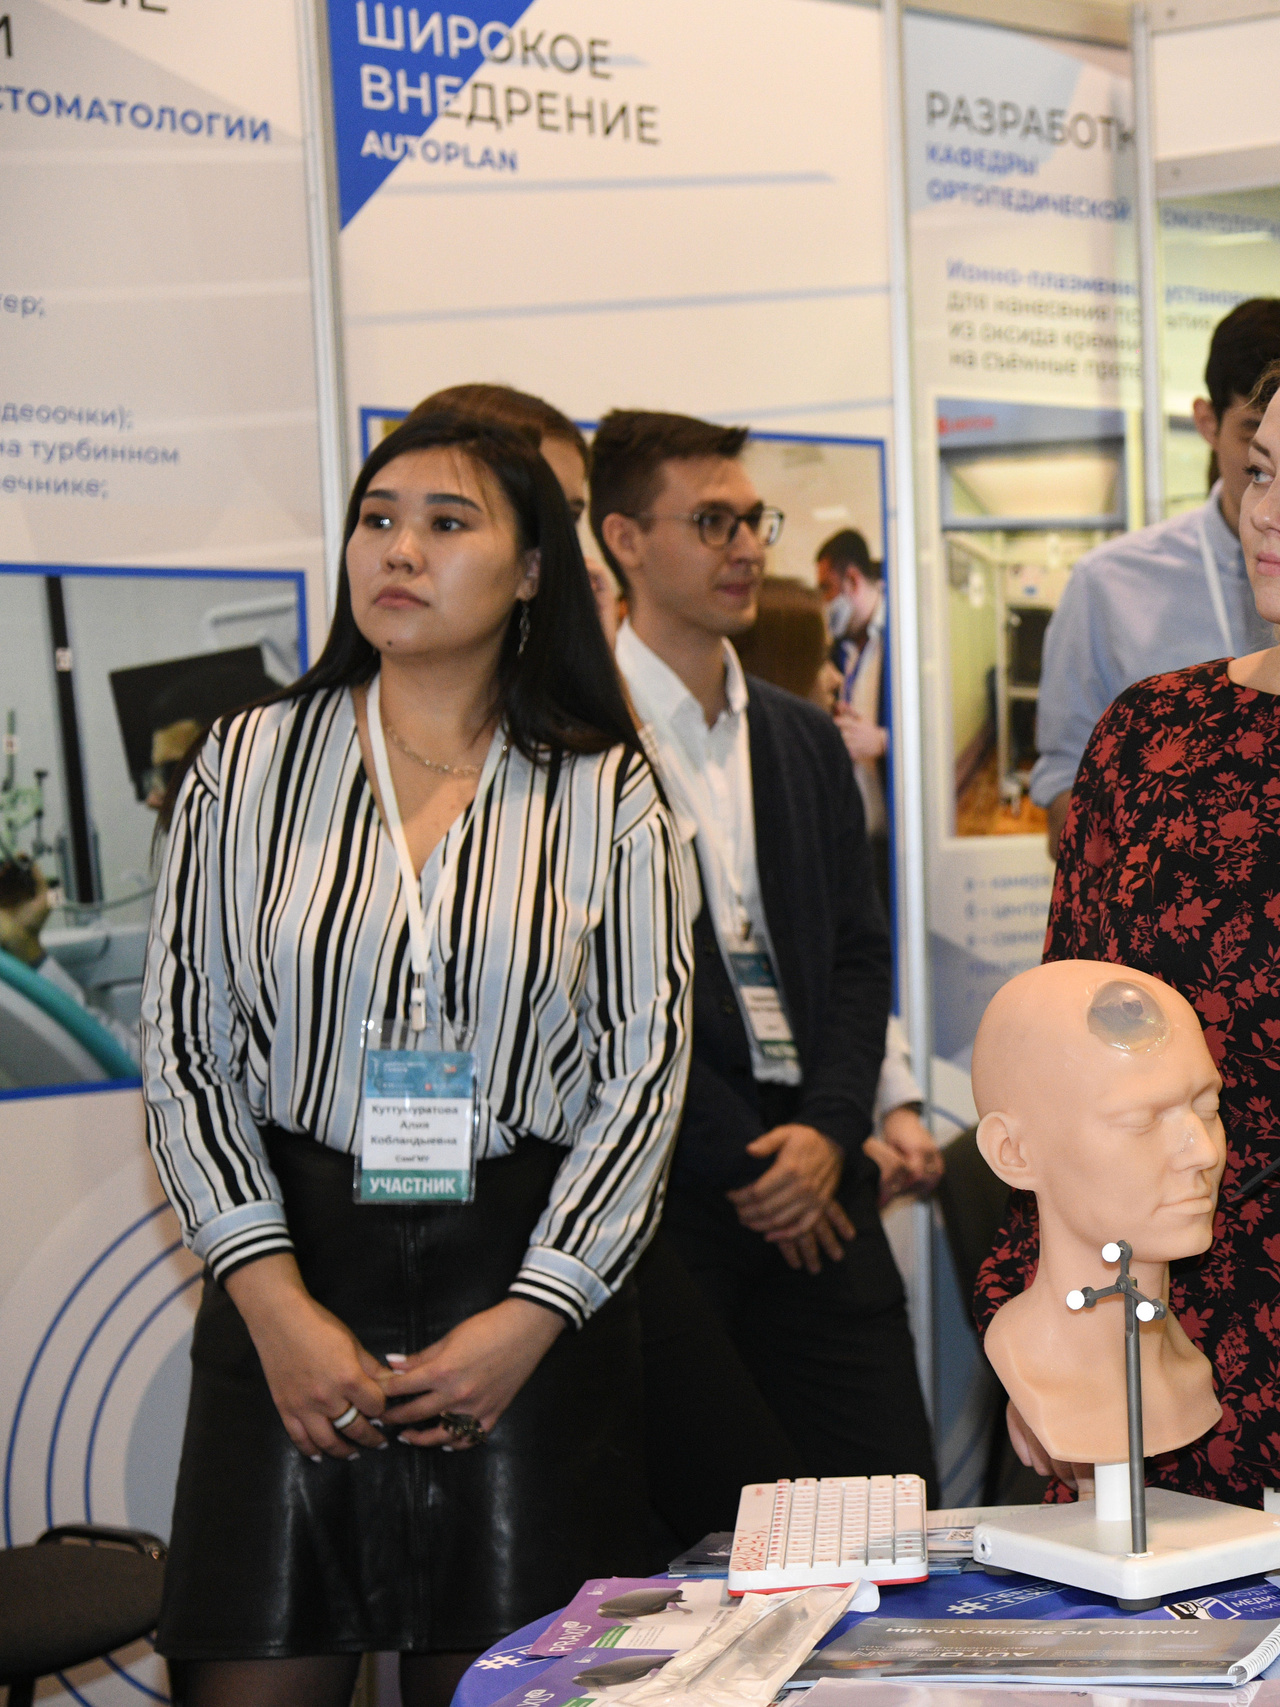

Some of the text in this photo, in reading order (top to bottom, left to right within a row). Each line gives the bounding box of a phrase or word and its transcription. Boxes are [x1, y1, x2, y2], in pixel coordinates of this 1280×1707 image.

[355, 0, 614, 80] ШИРОКОЕ
[0, 85, 273, 143] ТОМАТОЛОГИИ
[359, 63, 661, 146] ВНЕДРЕНИЕ
[926, 88, 1138, 152] РАЗРАБОТК
[360, 130, 518, 173] AUTOPLAN
[29, 437, 181, 466] турбинном
[369, 1177, 456, 1194] УЧАСТНИК
